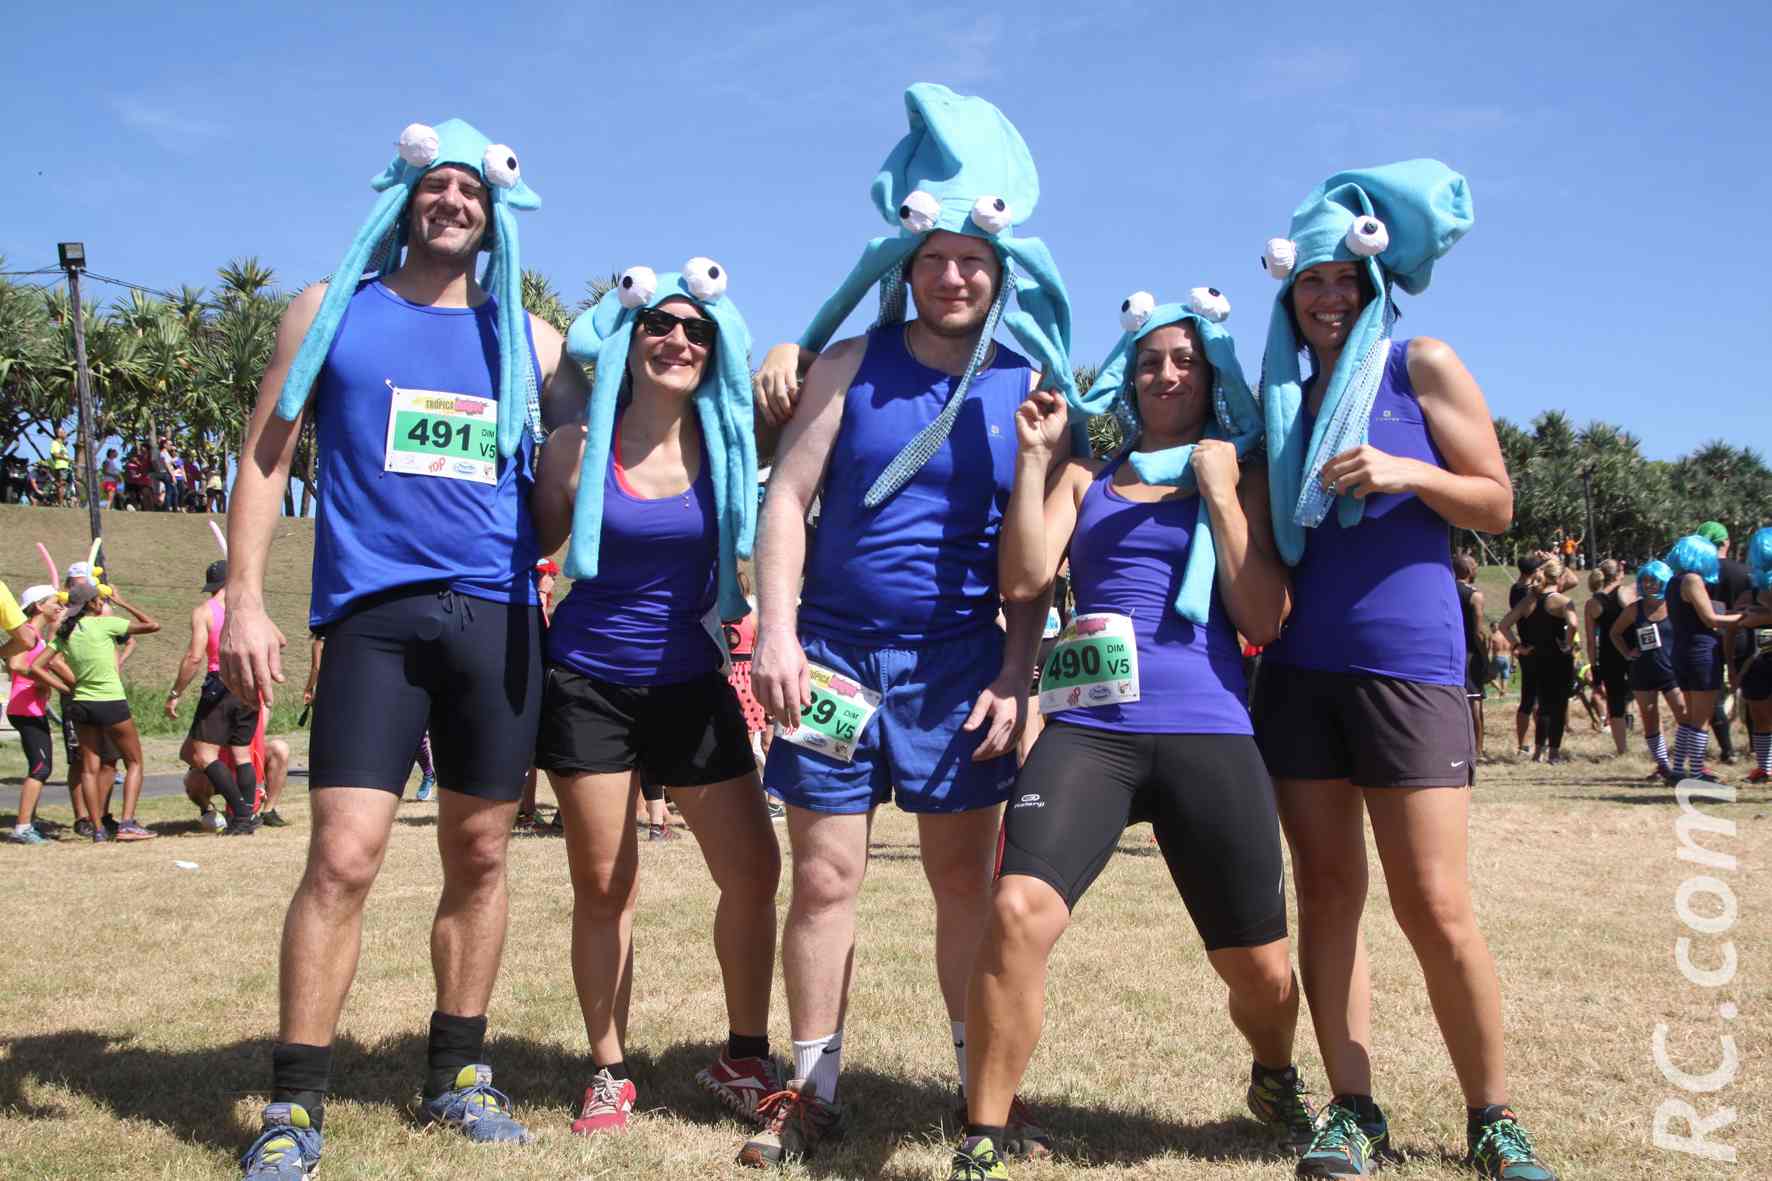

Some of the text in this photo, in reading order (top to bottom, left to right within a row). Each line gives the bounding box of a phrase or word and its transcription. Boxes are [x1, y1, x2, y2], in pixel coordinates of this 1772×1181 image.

[407, 418, 472, 452] 491
[481, 428, 495, 438] DIM
[480, 442, 496, 459] V5
[1107, 643, 1125, 654] DIM
[1048, 645, 1101, 681] 490
[1107, 658, 1130, 675] V5
[835, 719, 856, 741] V5
